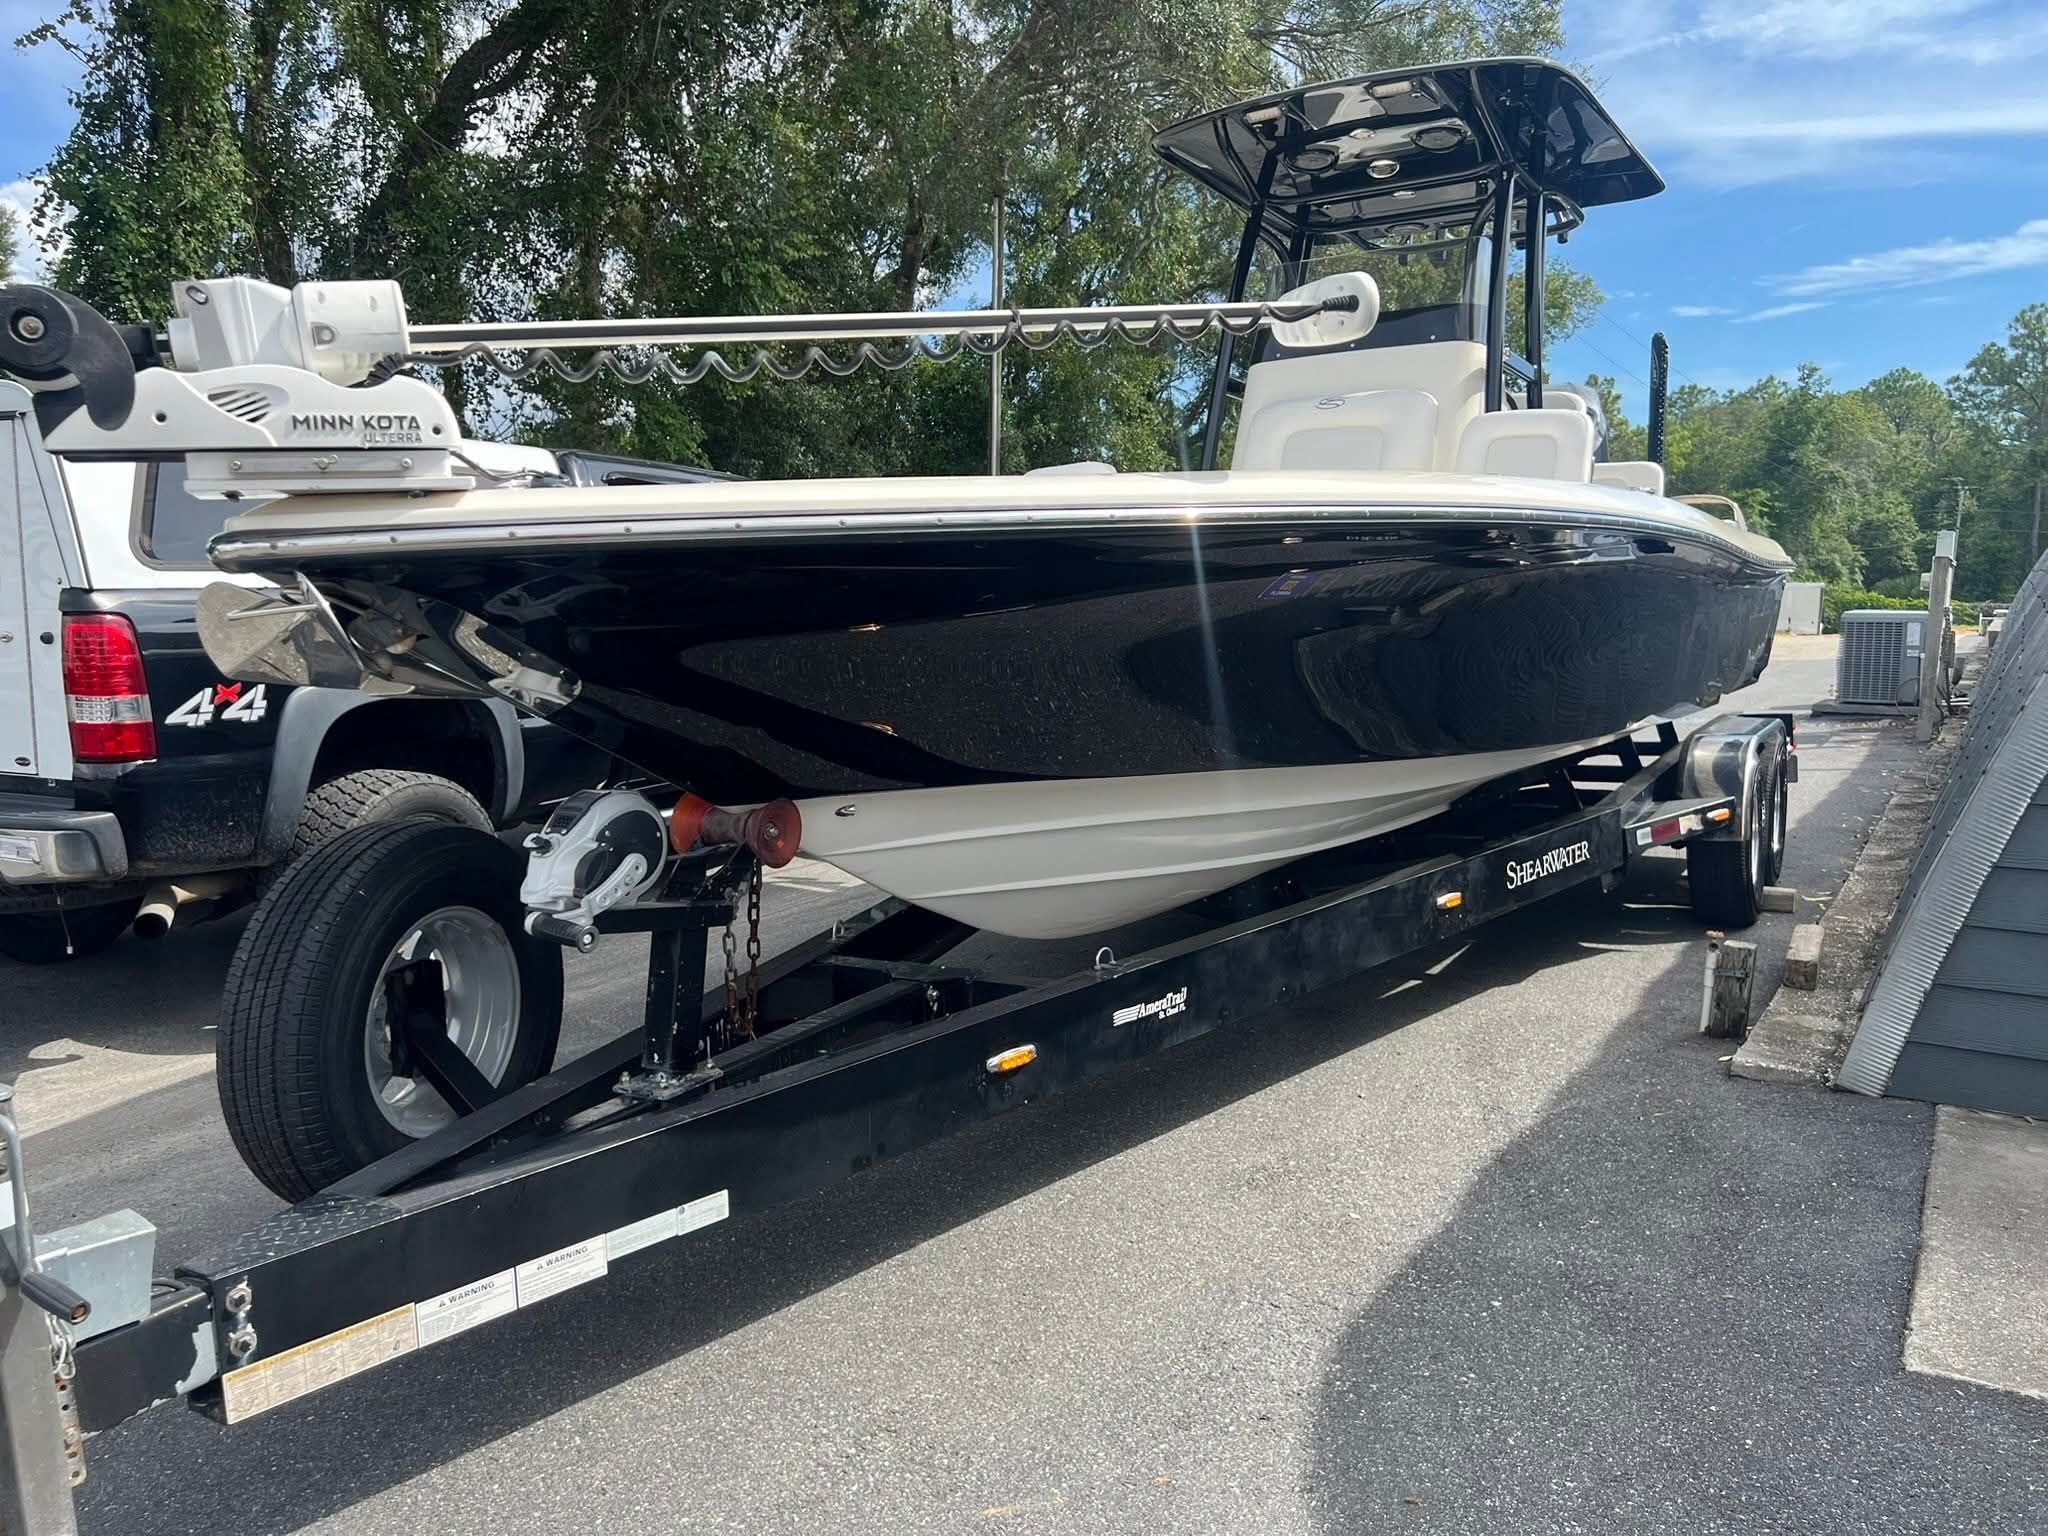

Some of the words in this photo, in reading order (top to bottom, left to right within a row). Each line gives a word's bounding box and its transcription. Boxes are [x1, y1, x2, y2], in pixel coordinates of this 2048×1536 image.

[292, 415, 354, 431] MINN
[361, 415, 421, 431] KOTA
[363, 433, 423, 444] ULTERRA
[545, 1245, 589, 1267] WARNING
[448, 1280, 496, 1304] WARNING
